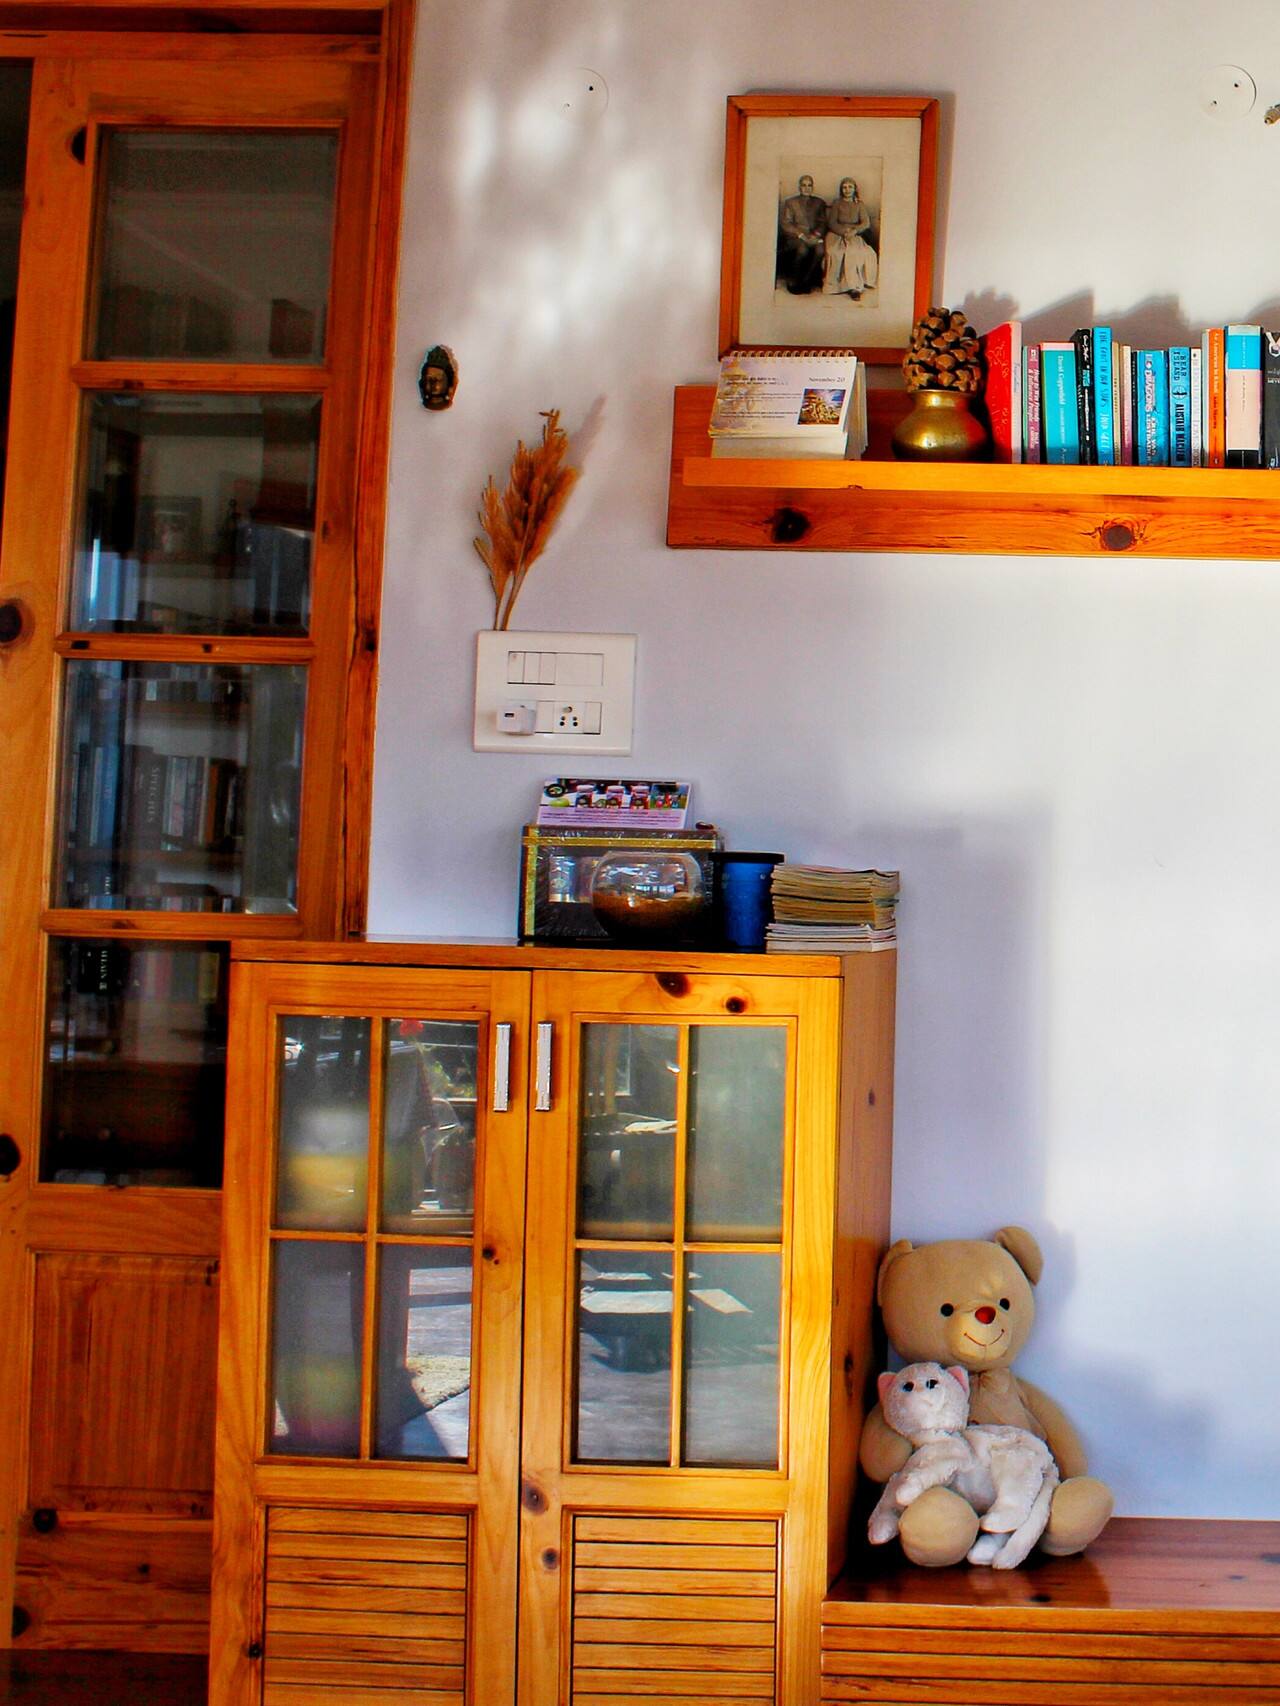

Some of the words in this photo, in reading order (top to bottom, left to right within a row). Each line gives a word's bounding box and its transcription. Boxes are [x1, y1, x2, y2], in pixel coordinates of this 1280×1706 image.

[1056, 356, 1066, 372] David
[1173, 352, 1181, 381] ISLAND
[1056, 373, 1066, 405] Copperfield
[1145, 370, 1153, 412] DRAGONS
[1175, 404, 1186, 431] ALISTAIR
